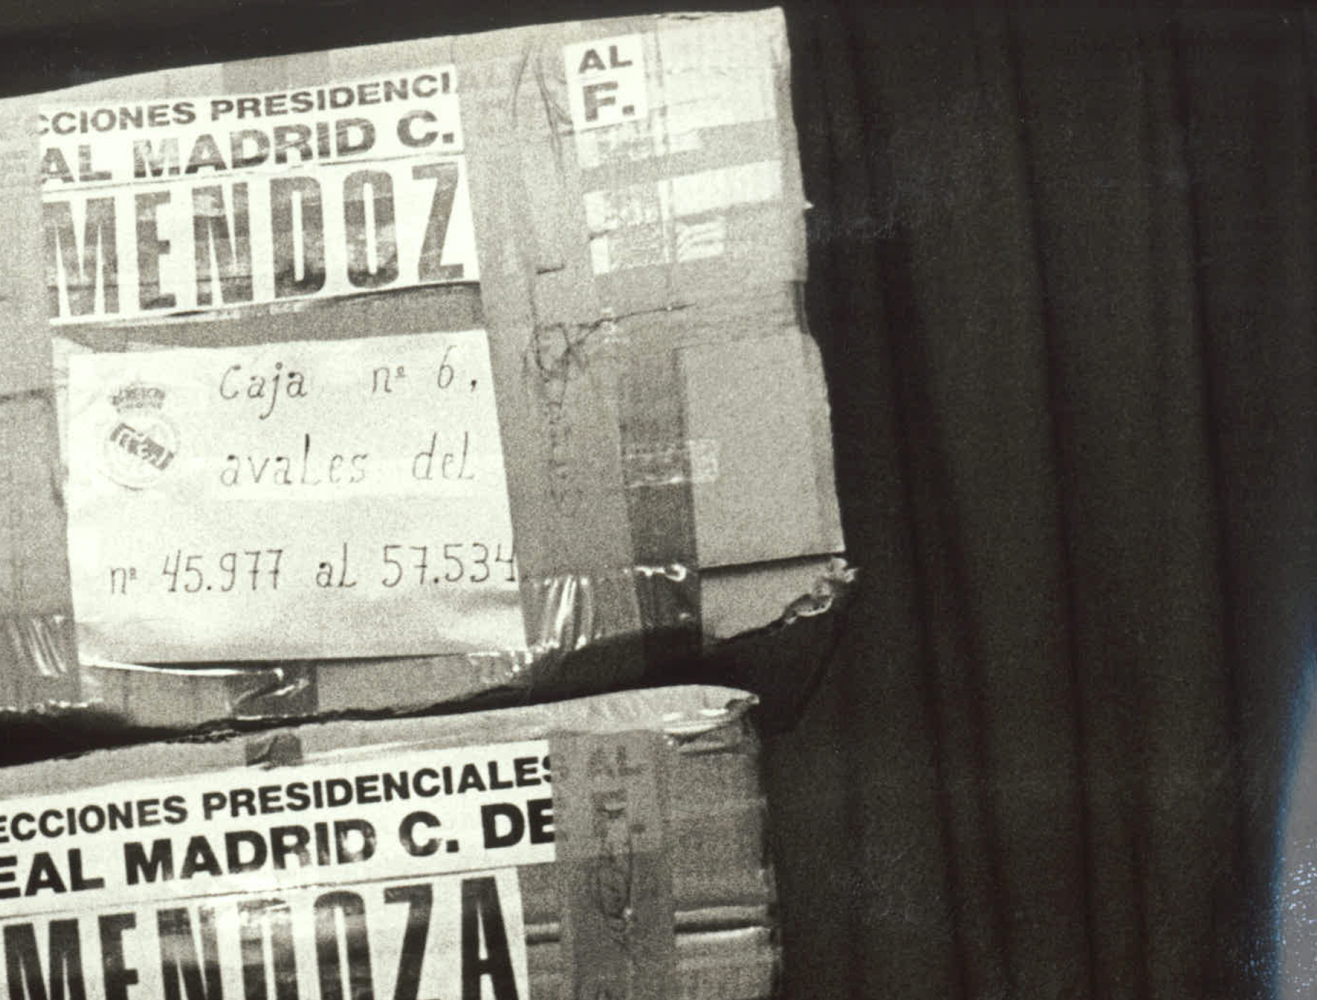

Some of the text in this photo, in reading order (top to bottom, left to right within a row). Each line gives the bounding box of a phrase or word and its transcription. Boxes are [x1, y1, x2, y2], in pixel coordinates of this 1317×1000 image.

[577, 48, 633, 75] AL
[133, 119, 376, 179] MADRID
[396, 109, 457, 149] C.
[582, 80, 637, 123] F.
[219, 362, 309, 420] Caja
[162, 548, 284, 594] 45.977
[381, 542, 518, 587] 57.534
[202, 756, 553, 821] PRESIDENCIALES
[124, 817, 378, 887] MADRID
[397, 811, 460, 859] C.
[481, 798, 556, 851] DE
